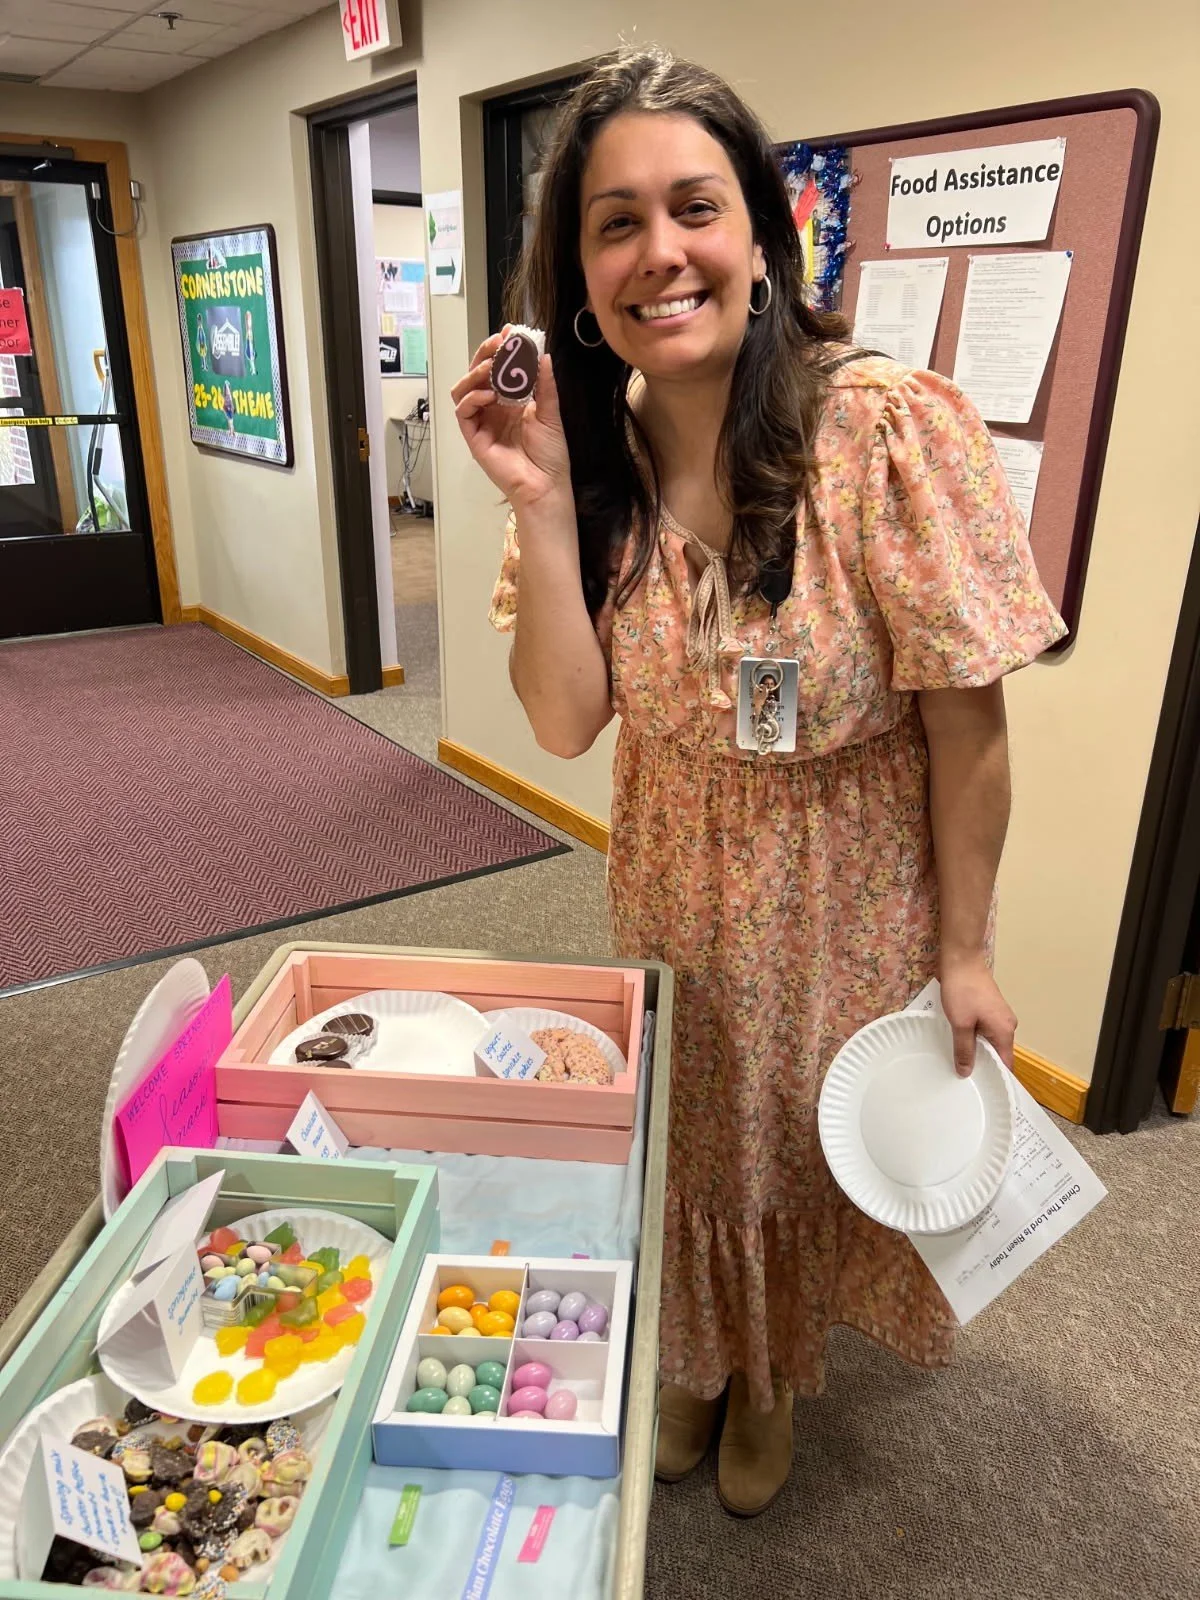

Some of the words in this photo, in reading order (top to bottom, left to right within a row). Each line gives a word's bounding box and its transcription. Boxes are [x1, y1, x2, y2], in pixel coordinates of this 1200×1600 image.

[347, 0, 379, 50] EXIT
[891, 168, 938, 197] Food
[944, 163, 1060, 192] Assistance
[926, 211, 1007, 243] Options
[181, 266, 263, 300] CORNERSTONE
[194, 384, 226, 410] 25-26
[232, 389, 275, 419] THEME
[126, 1064, 169, 1123] WELCOME
[1046, 1202, 1062, 1216] The
[1059, 1184, 1081, 1205] Christ
[1023, 1227, 1032, 1237] Is
[1031, 1213, 1049, 1232] Lord
[1006, 1235, 1026, 1253] Risen
[989, 1251, 1010, 1270] Today
[476, 1508, 504, 1576] Chocolate
